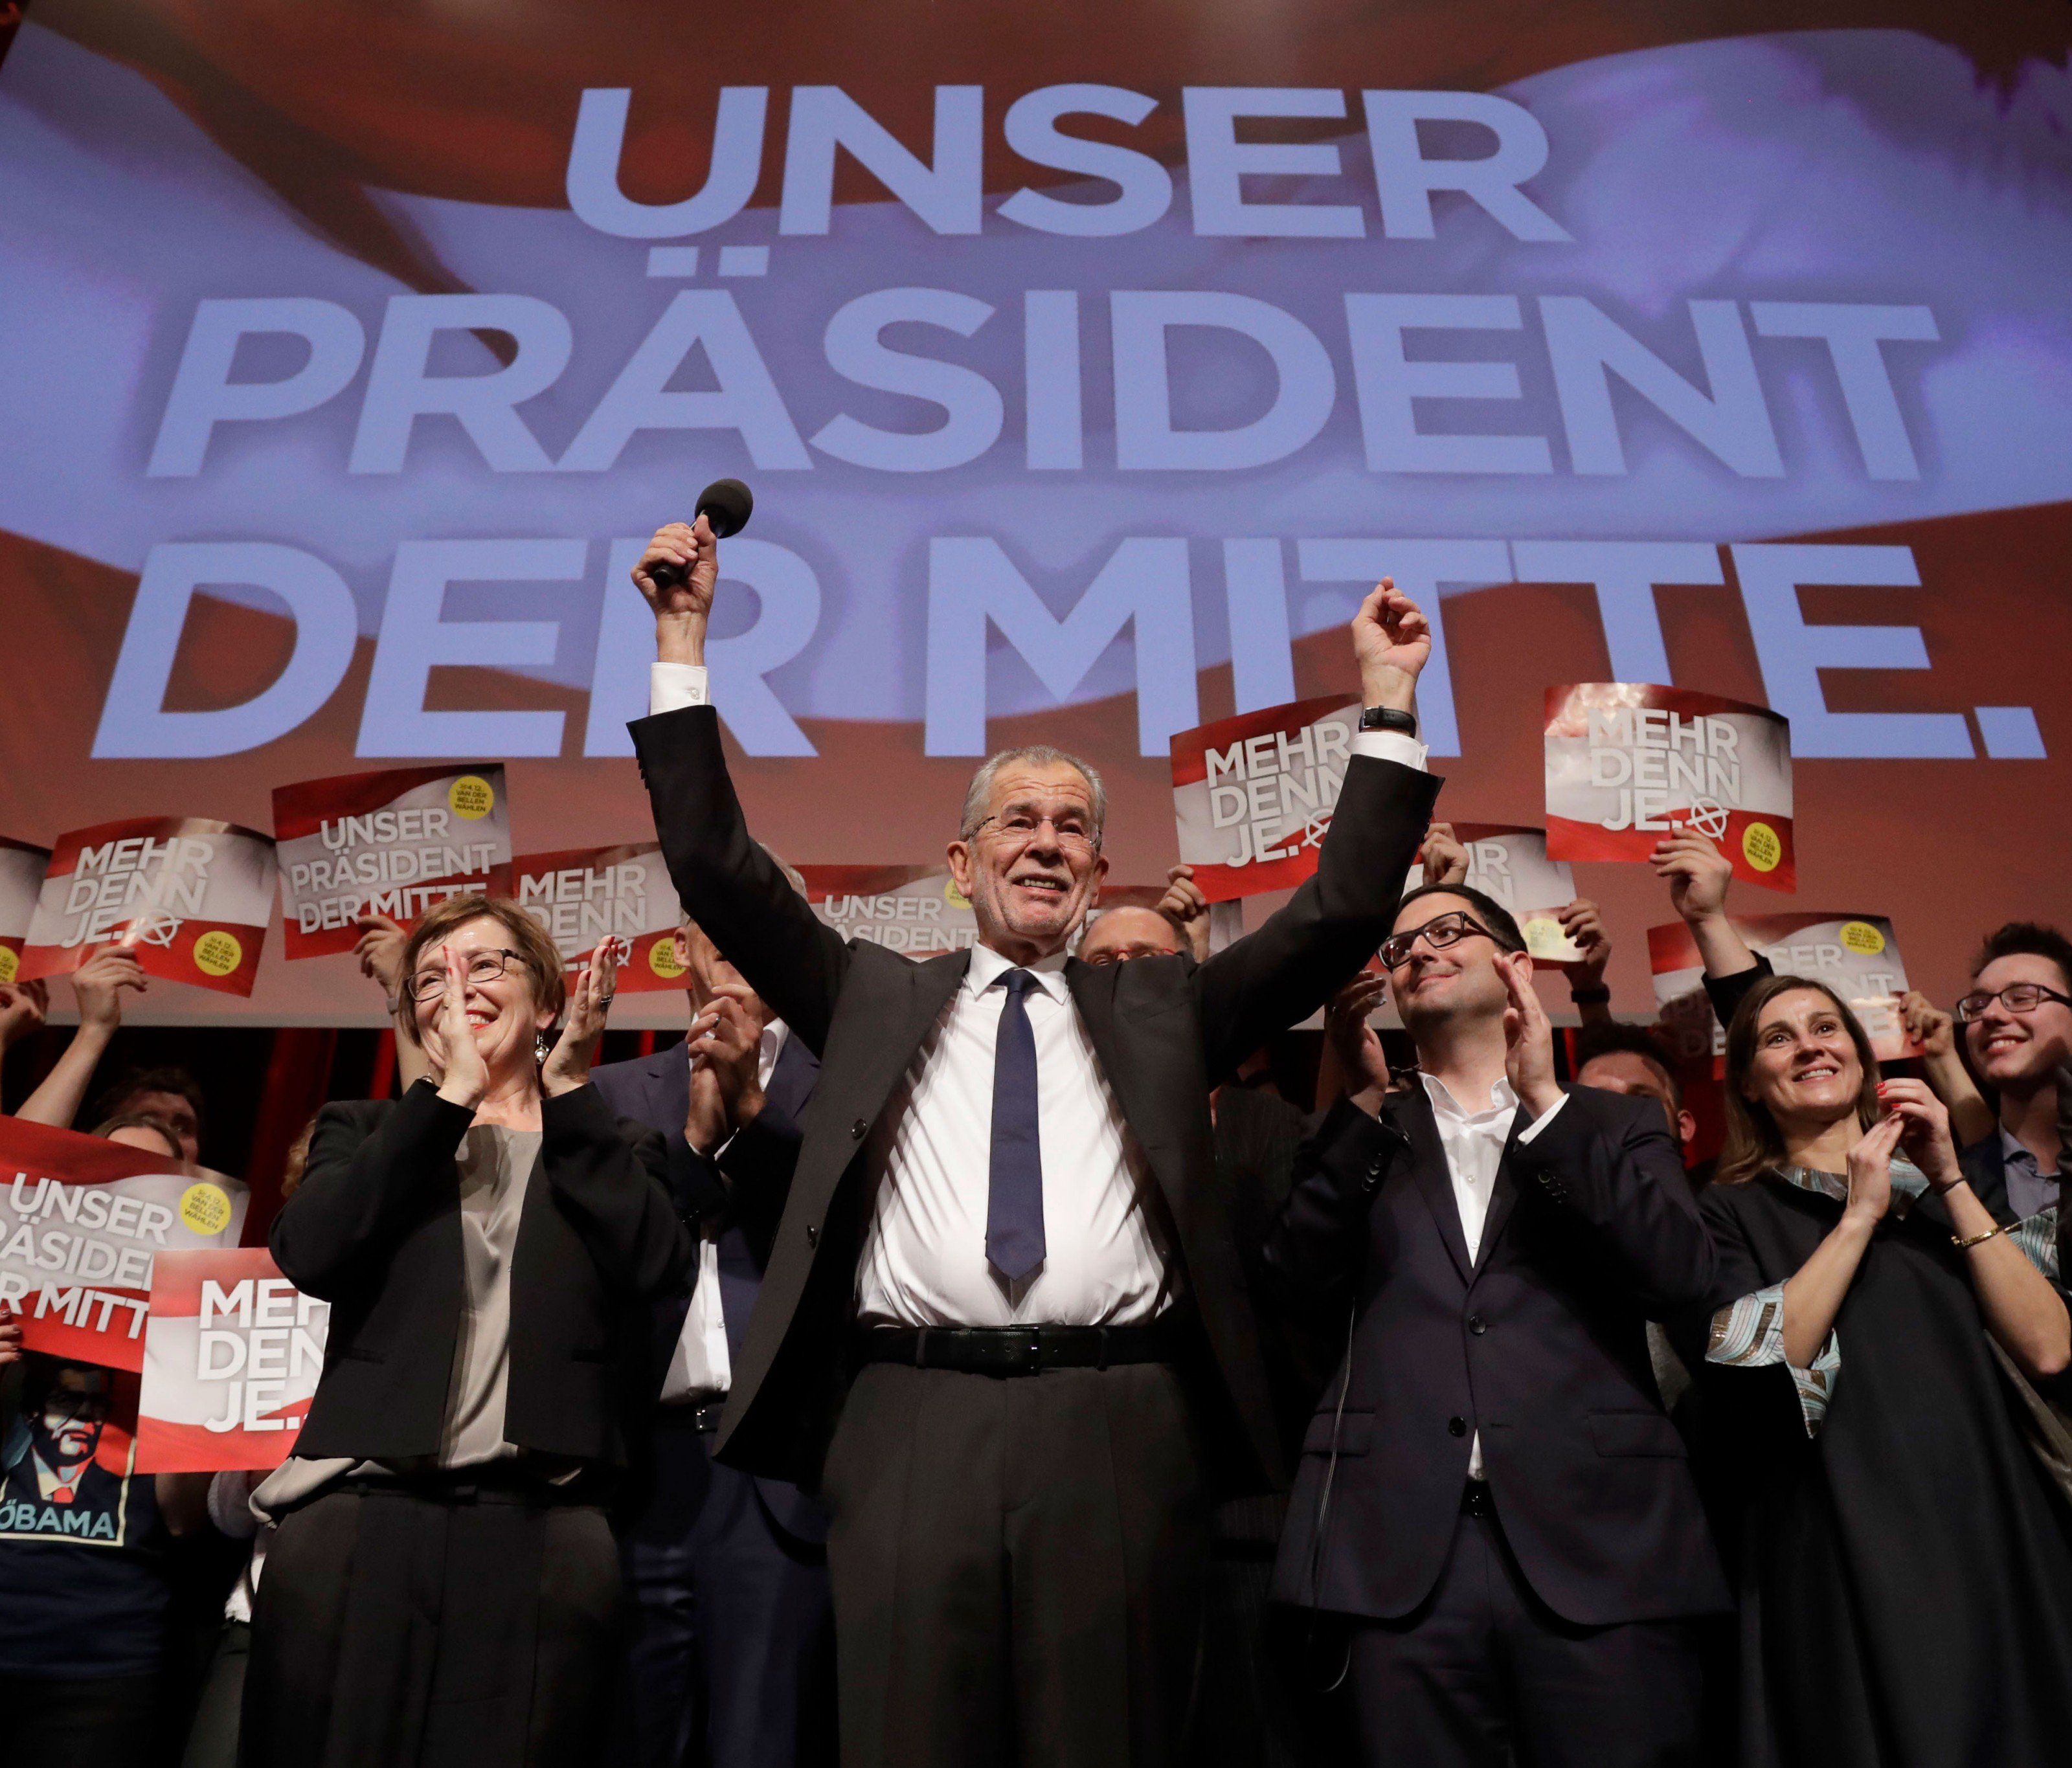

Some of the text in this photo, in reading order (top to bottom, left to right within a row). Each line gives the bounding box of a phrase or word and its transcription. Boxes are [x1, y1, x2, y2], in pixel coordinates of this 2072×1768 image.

[565, 82, 1575, 242] UNSER
[146, 246, 1941, 482] PRÄSIDENT
[89, 536, 2047, 759] DER MITTE.
[1204, 721, 1352, 789] MEHR
[1588, 707, 1740, 764] MEHR
[1590, 746, 1740, 805] DENN
[321, 808, 449, 850] UNSER
[1601, 788, 1684, 832] JE.
[74, 836, 214, 881] MEHR
[1226, 816, 1300, 868] JE.
[64, 870, 208, 915] DENN
[291, 844, 497, 897] PRÄSIDENT
[519, 864, 646, 906] MEHR
[60, 906, 126, 949] JE.
[298, 894, 362, 934] DER
[824, 895, 943, 921] UNSER
[9, 1172, 174, 1245] UNSER
[0, 1213, 154, 1292] ÄSIDE
[203, 1380, 301, 1433] JE.
[0, 1498, 116, 1539] ÖBAMA
